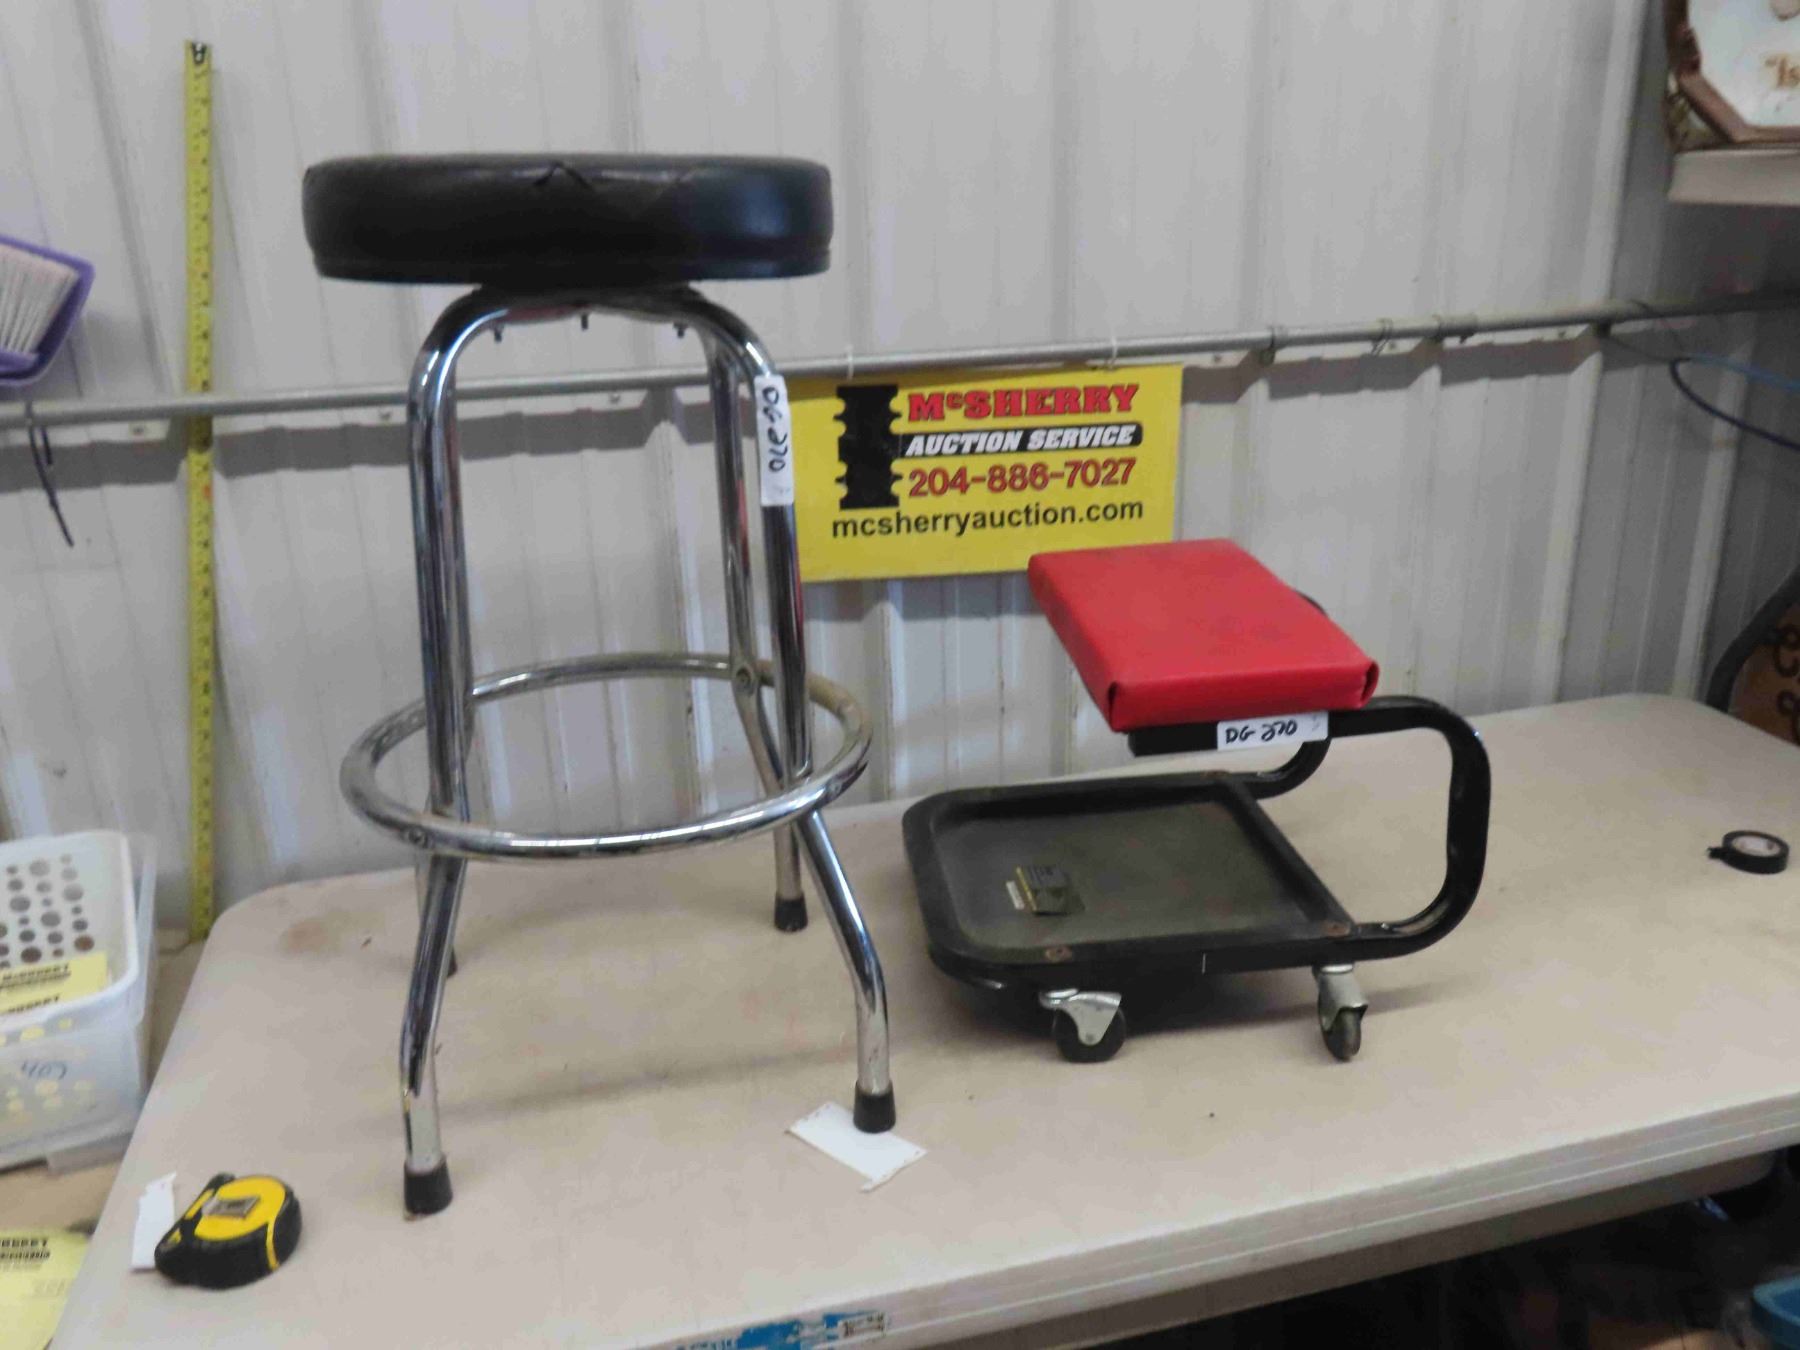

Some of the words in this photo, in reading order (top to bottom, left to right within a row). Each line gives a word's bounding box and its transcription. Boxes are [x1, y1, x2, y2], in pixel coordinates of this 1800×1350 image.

[905, 430, 1024, 457] AUCTION
[1027, 424, 1137, 450] SERVICE
[909, 457, 1137, 498] 204-886-7027
[832, 501, 1144, 537] mcsherryauction.com
